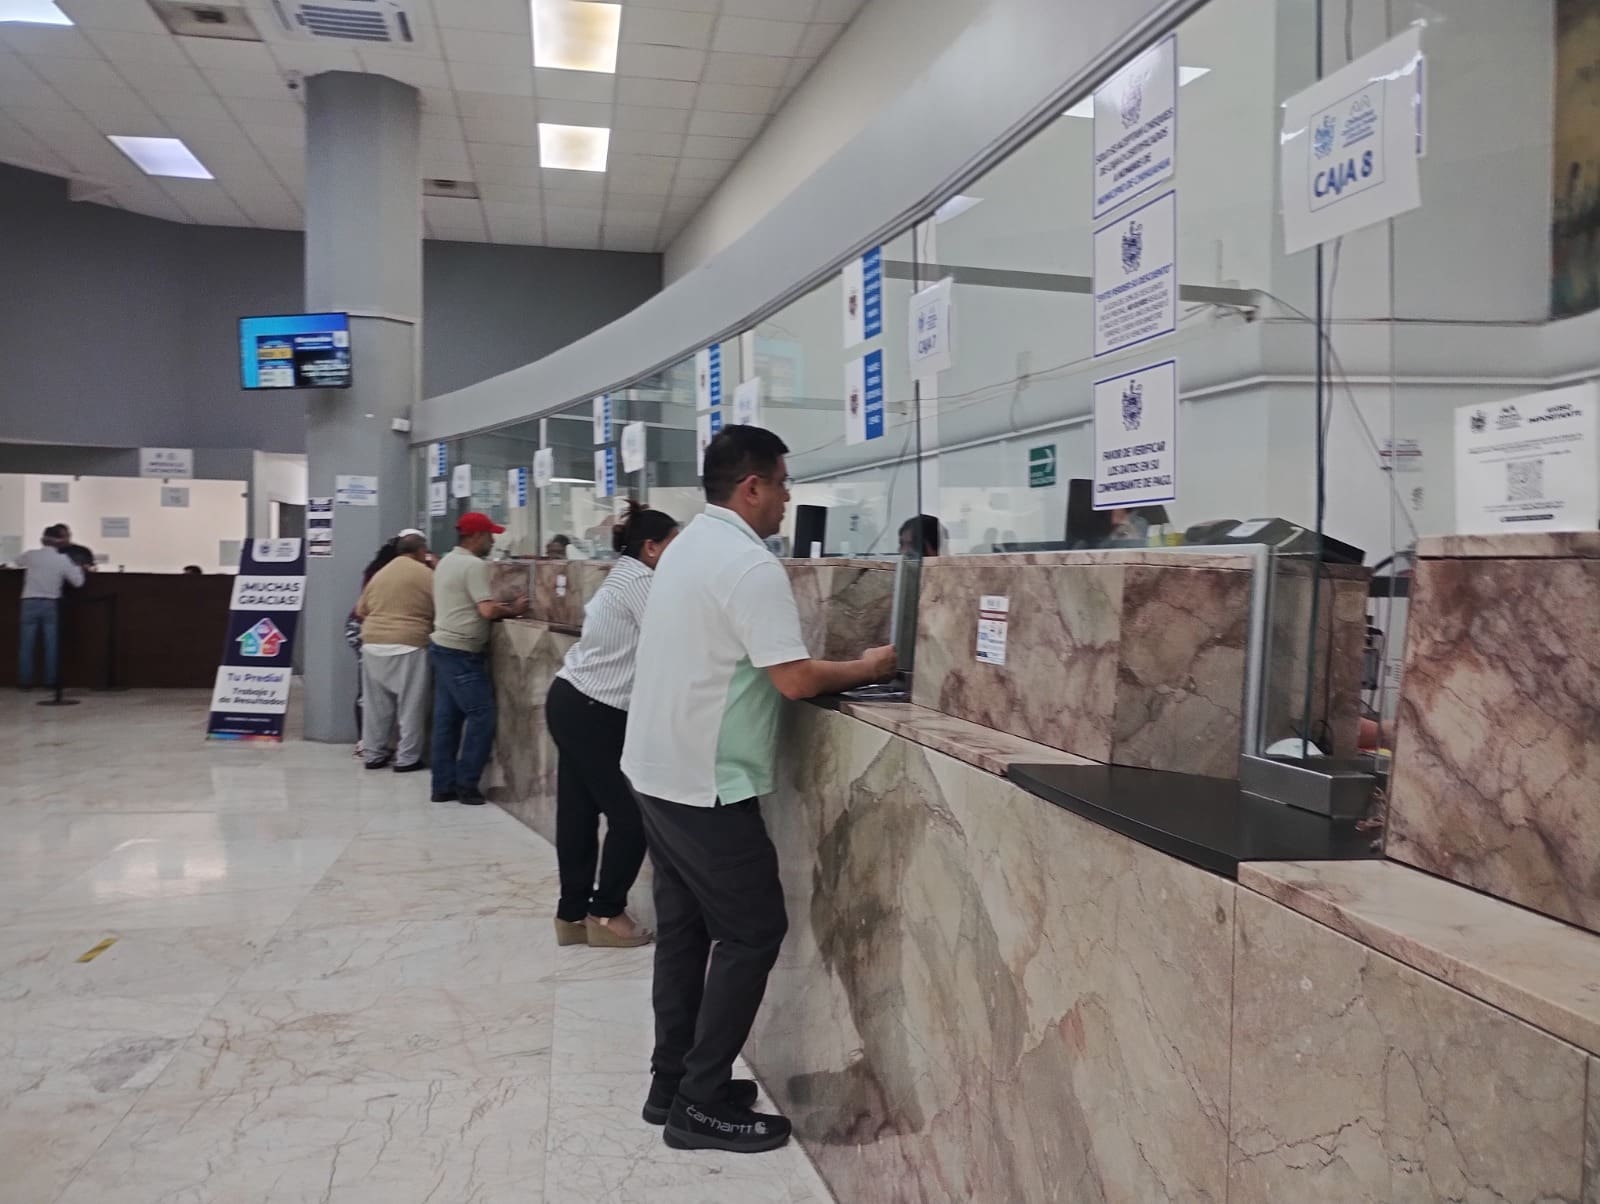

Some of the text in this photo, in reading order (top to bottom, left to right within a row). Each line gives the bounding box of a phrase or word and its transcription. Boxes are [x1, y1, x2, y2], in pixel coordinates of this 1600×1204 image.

[1314, 150, 1373, 198] CAJA 8
[227, 672, 284, 683] Tu Predial
[685, 1104, 753, 1135] carhartt
